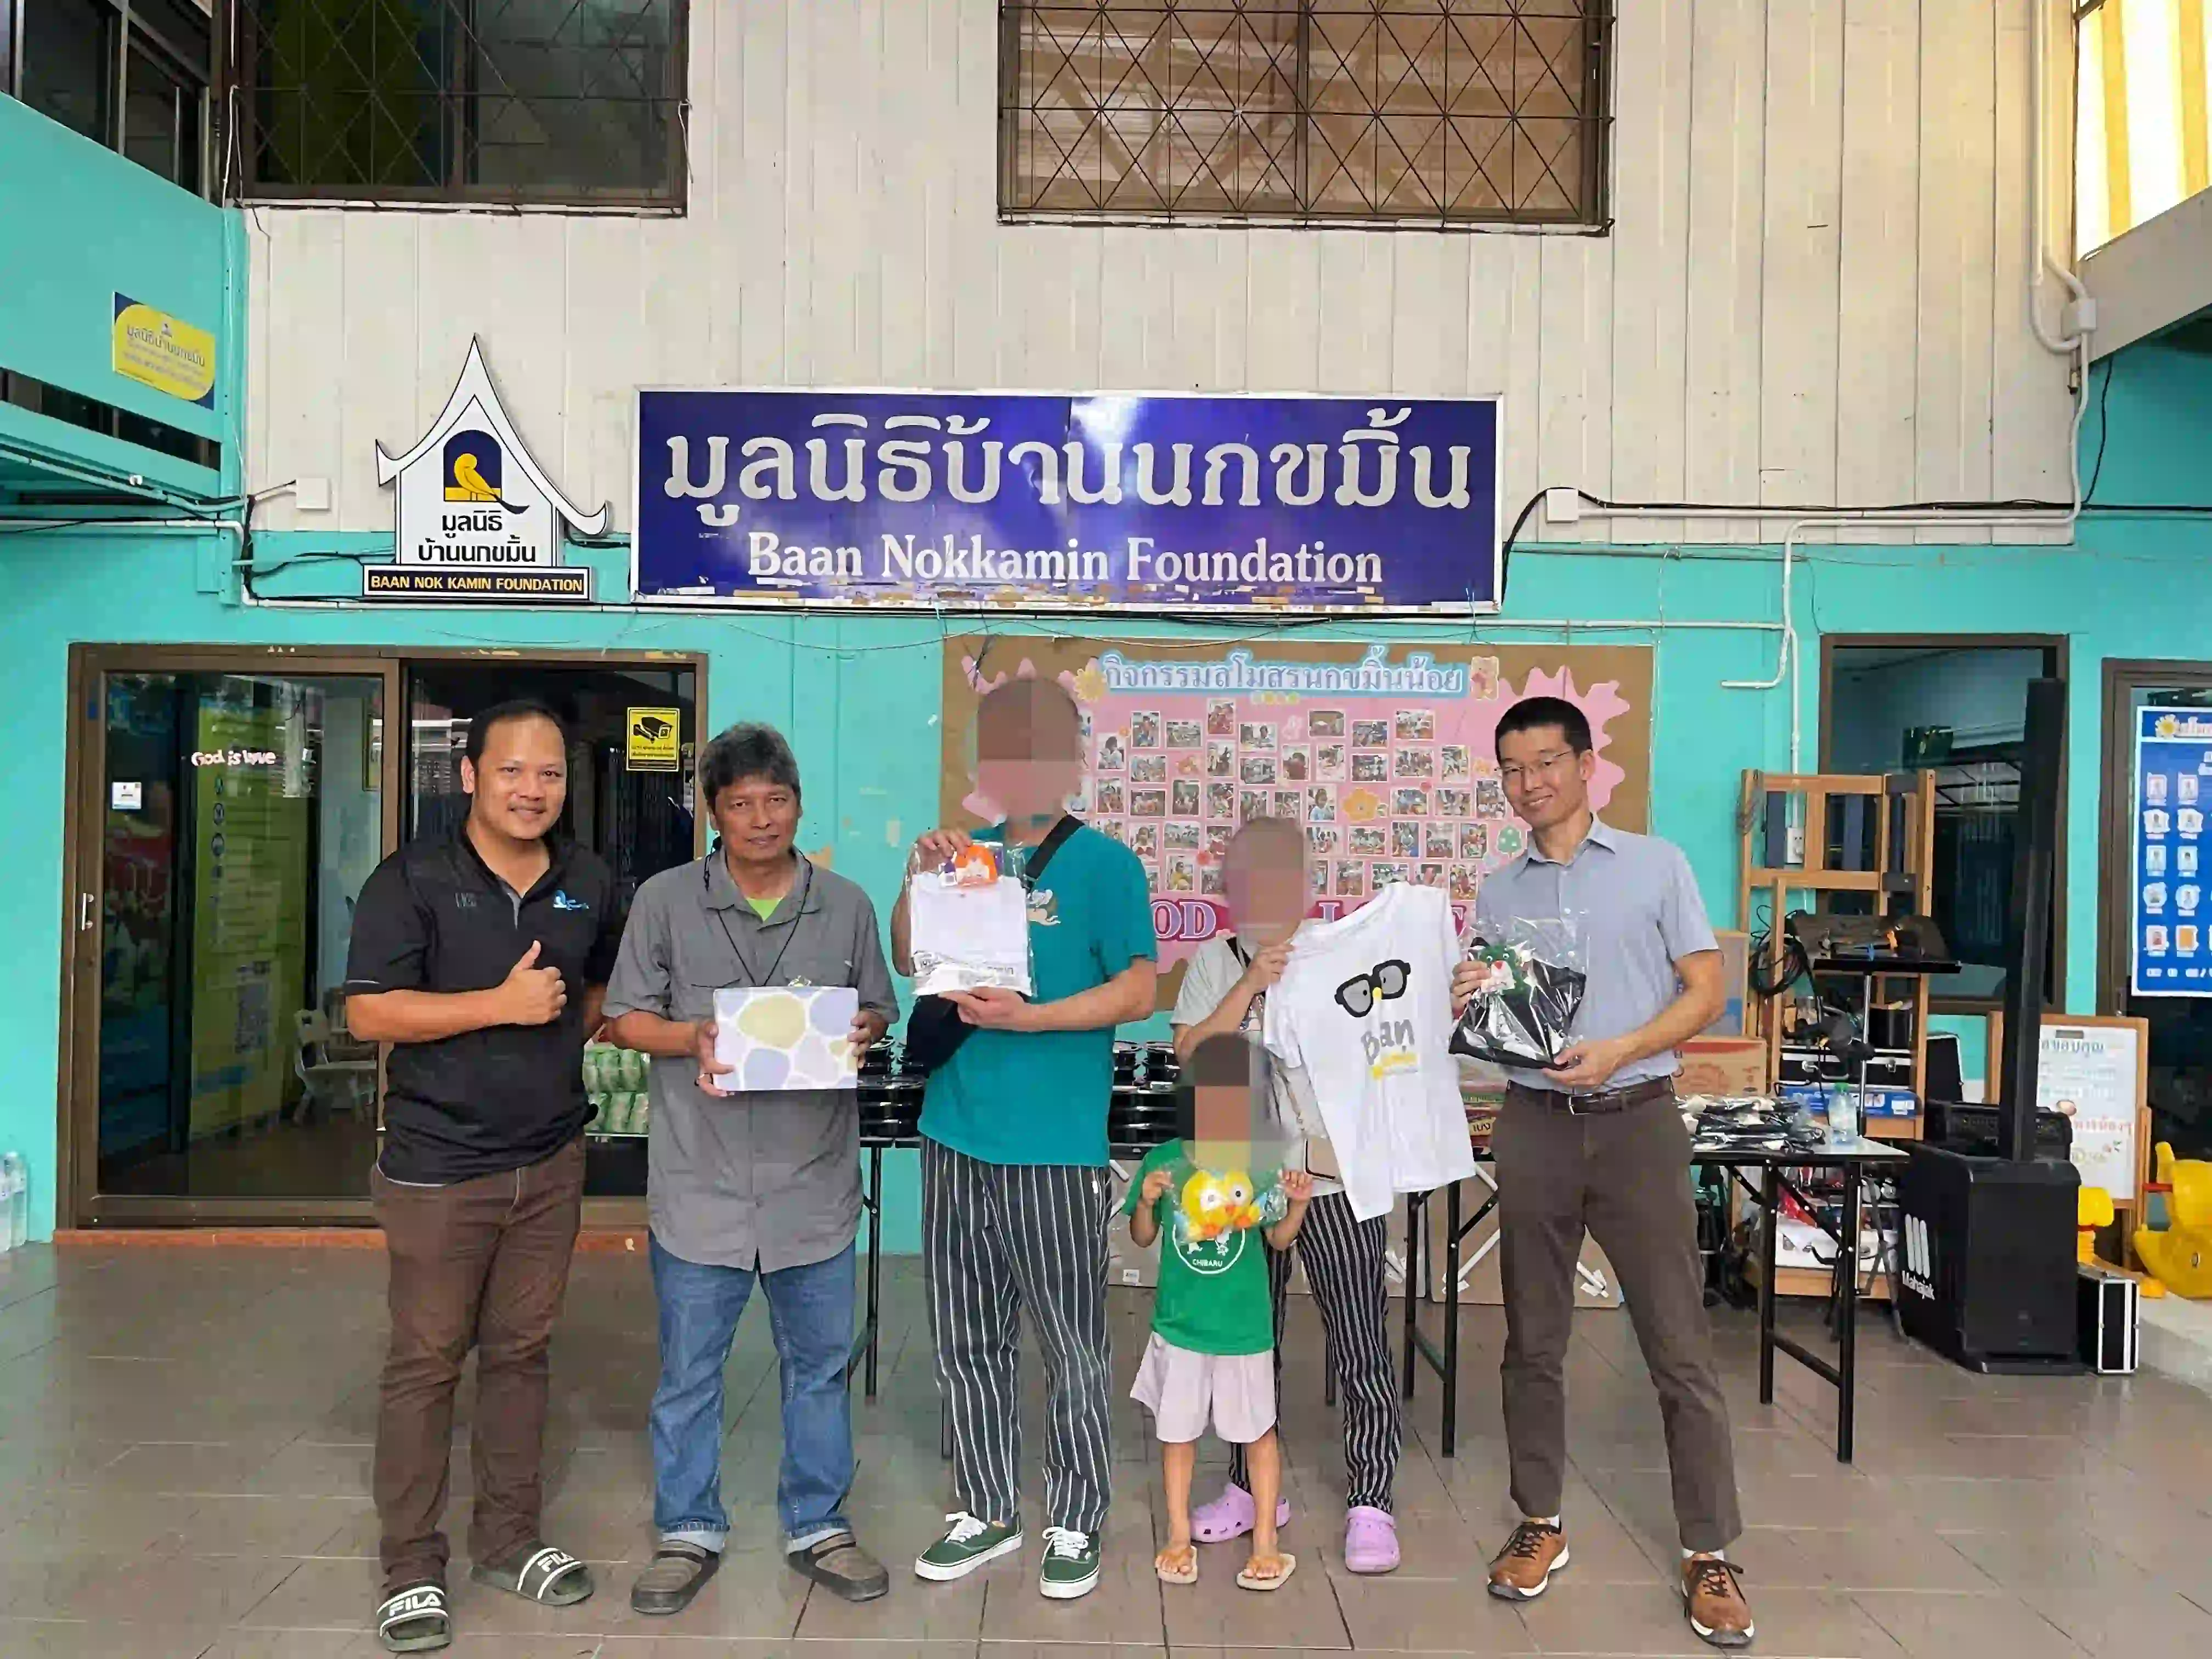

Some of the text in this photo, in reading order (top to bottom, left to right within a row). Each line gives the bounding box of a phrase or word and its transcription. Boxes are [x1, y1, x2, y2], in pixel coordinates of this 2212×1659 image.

[664, 408, 1471, 526] มูลนิธิบ้านนกขมิ้น
[442, 510, 503, 538] มูลนิธิ
[418, 534, 536, 563] บ้านนกขมิ้น
[748, 532, 1383, 583] Baan Nokkamin Foundation
[371, 575, 582, 591] BAAN NOK KAMIN FOUNDATION
[191, 749, 225, 766] God
[227, 751, 242, 766] is
[1150, 900, 1216, 939] OD
[537, 1551, 575, 1573] FILA
[389, 1593, 442, 1616] FILA
